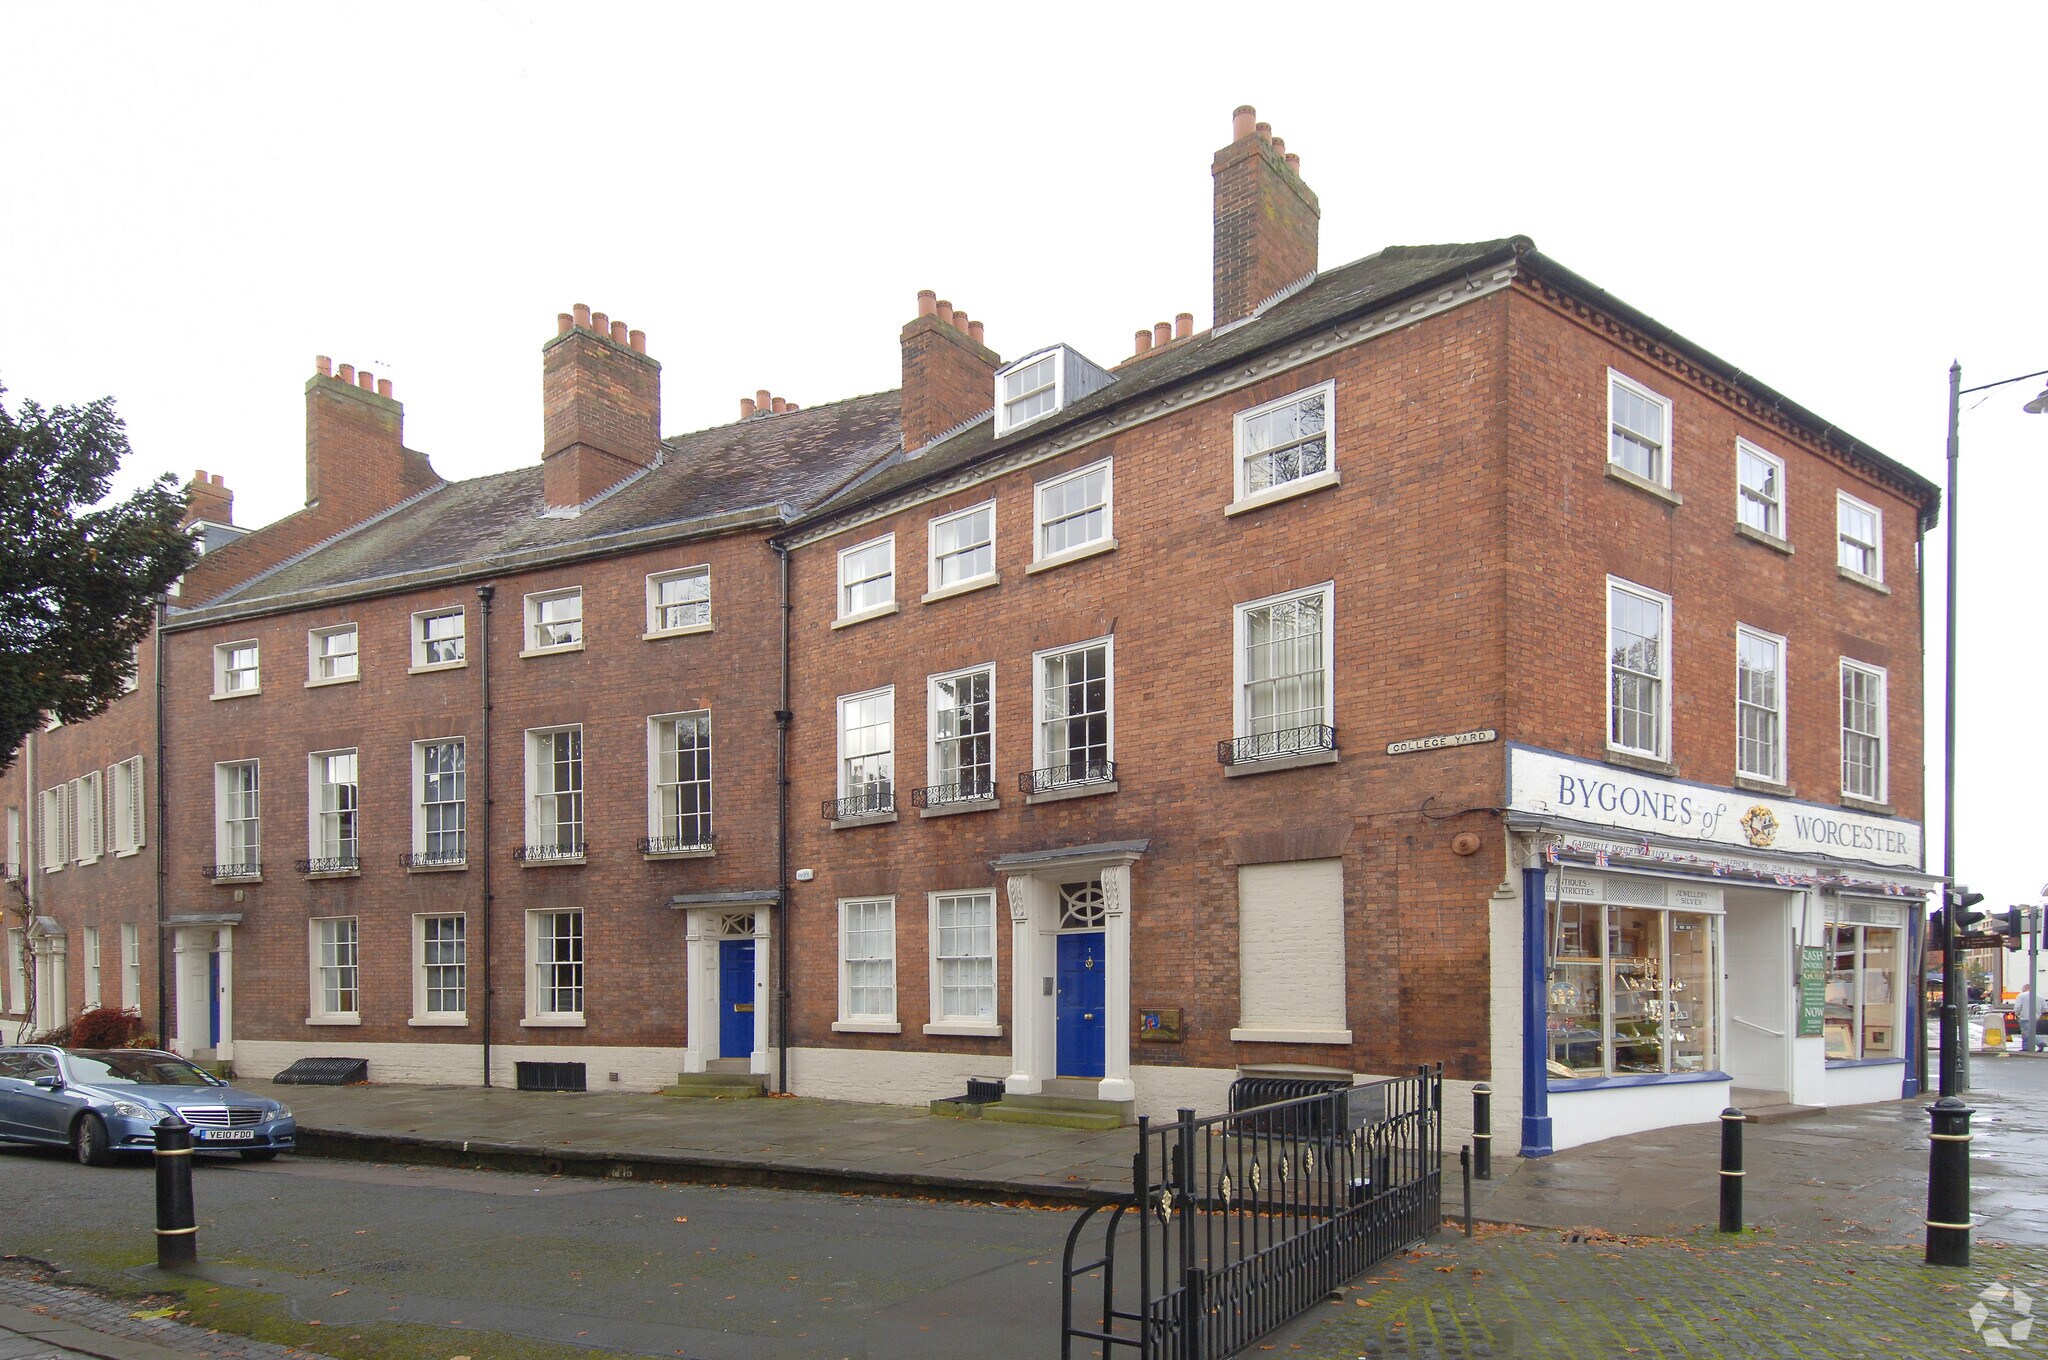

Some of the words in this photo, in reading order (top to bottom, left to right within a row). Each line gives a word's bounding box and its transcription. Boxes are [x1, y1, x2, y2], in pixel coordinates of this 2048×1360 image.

[1393, 737, 1446, 752] COLLEGE
[1455, 732, 1486, 744] YARD
[1558, 774, 1692, 825] BYGONES
[1700, 803, 1727, 839] of
[1794, 815, 1908, 854] WORCESTER
[1554, 878, 1587, 888] ATIQUES
[1545, 884, 1595, 896] ECCNTRICITIES
[1675, 889, 1707, 899] JEWELLERY
[1681, 897, 1703, 906] SILVER
[1803, 949, 1823, 961] CASH
[1804, 970, 1824, 980] GOLD
[1805, 1007, 1824, 1017] NOW
